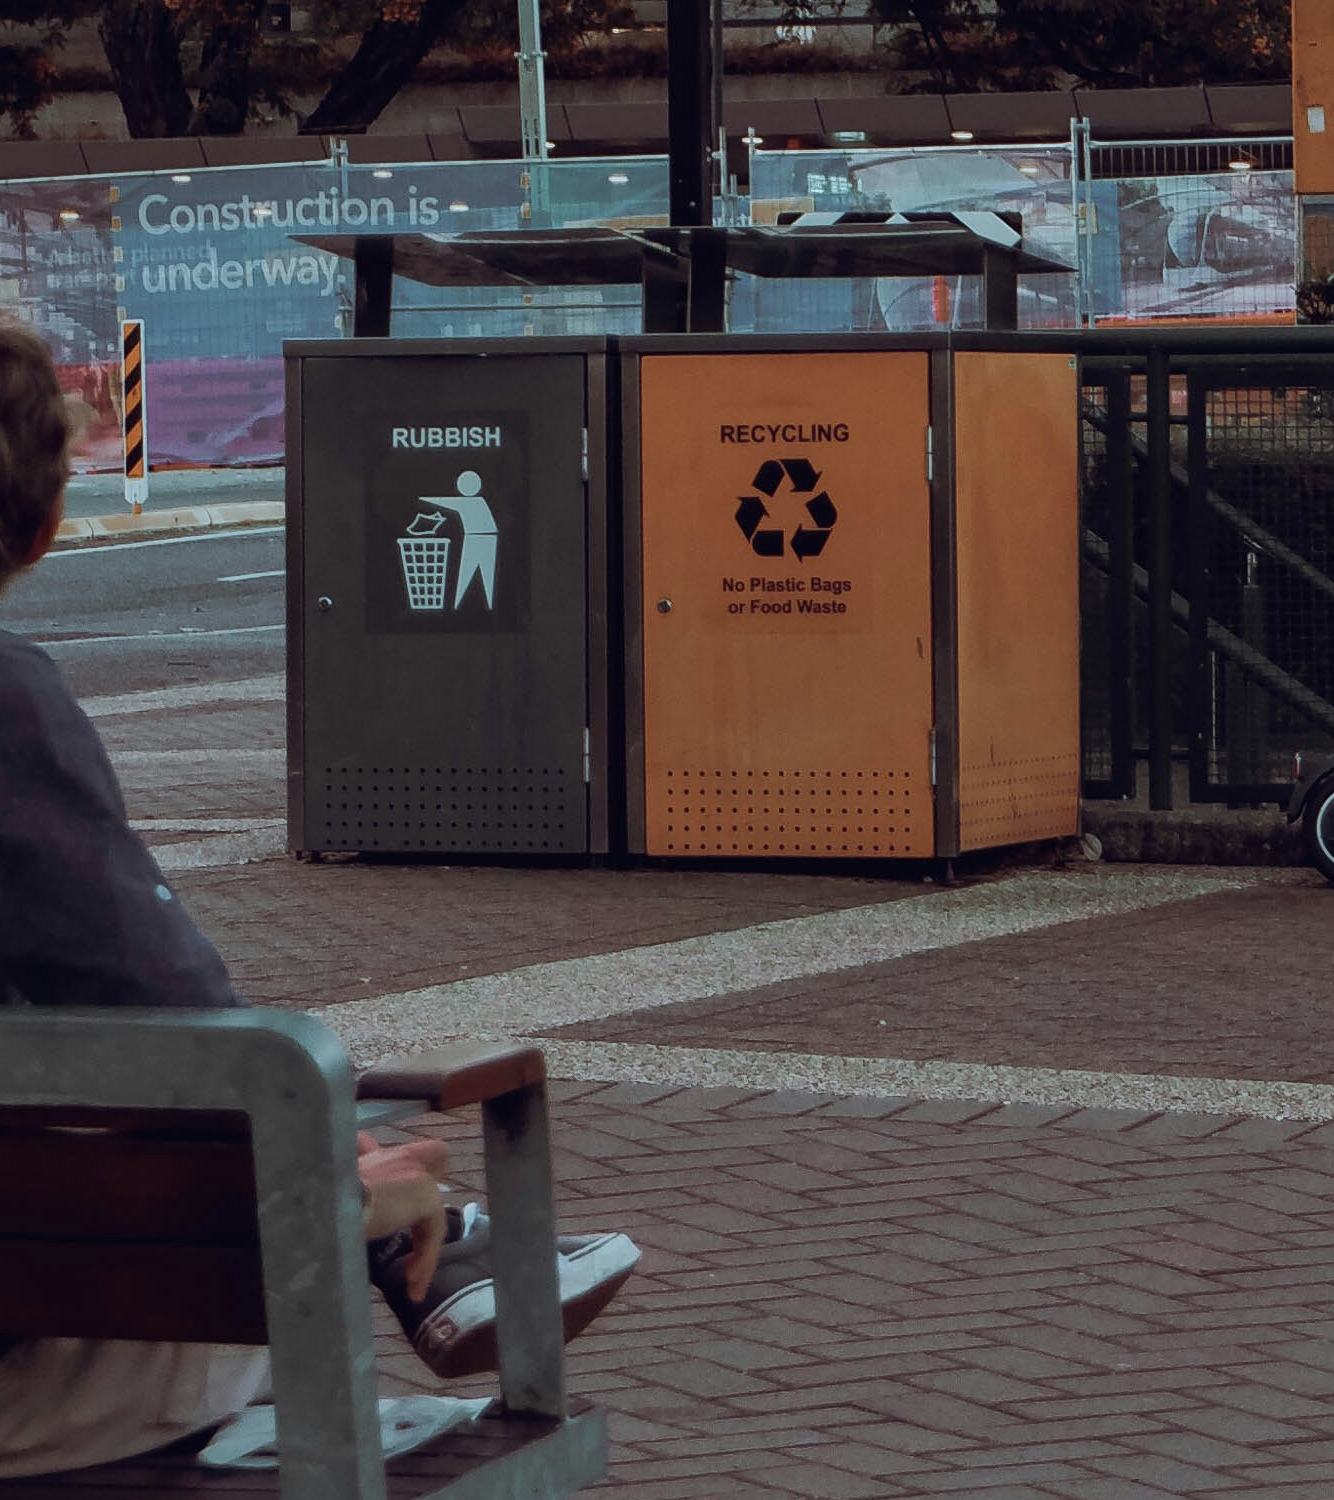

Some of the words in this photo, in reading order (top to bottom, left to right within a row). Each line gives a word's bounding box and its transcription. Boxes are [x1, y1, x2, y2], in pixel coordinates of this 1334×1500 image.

[138, 185, 395, 235] Construction
[408, 184, 440, 226] is
[142, 247, 346, 296] underway.
[392, 426, 501, 449] RUBBISH
[720, 423, 850, 443] RECYCLING
[722, 577, 745, 592] No
[750, 577, 806, 592] Plastic
[810, 576, 852, 595] Bags
[728, 602, 745, 614] or
[750, 599, 792, 614] Food
[797, 599, 847, 614] Waste
